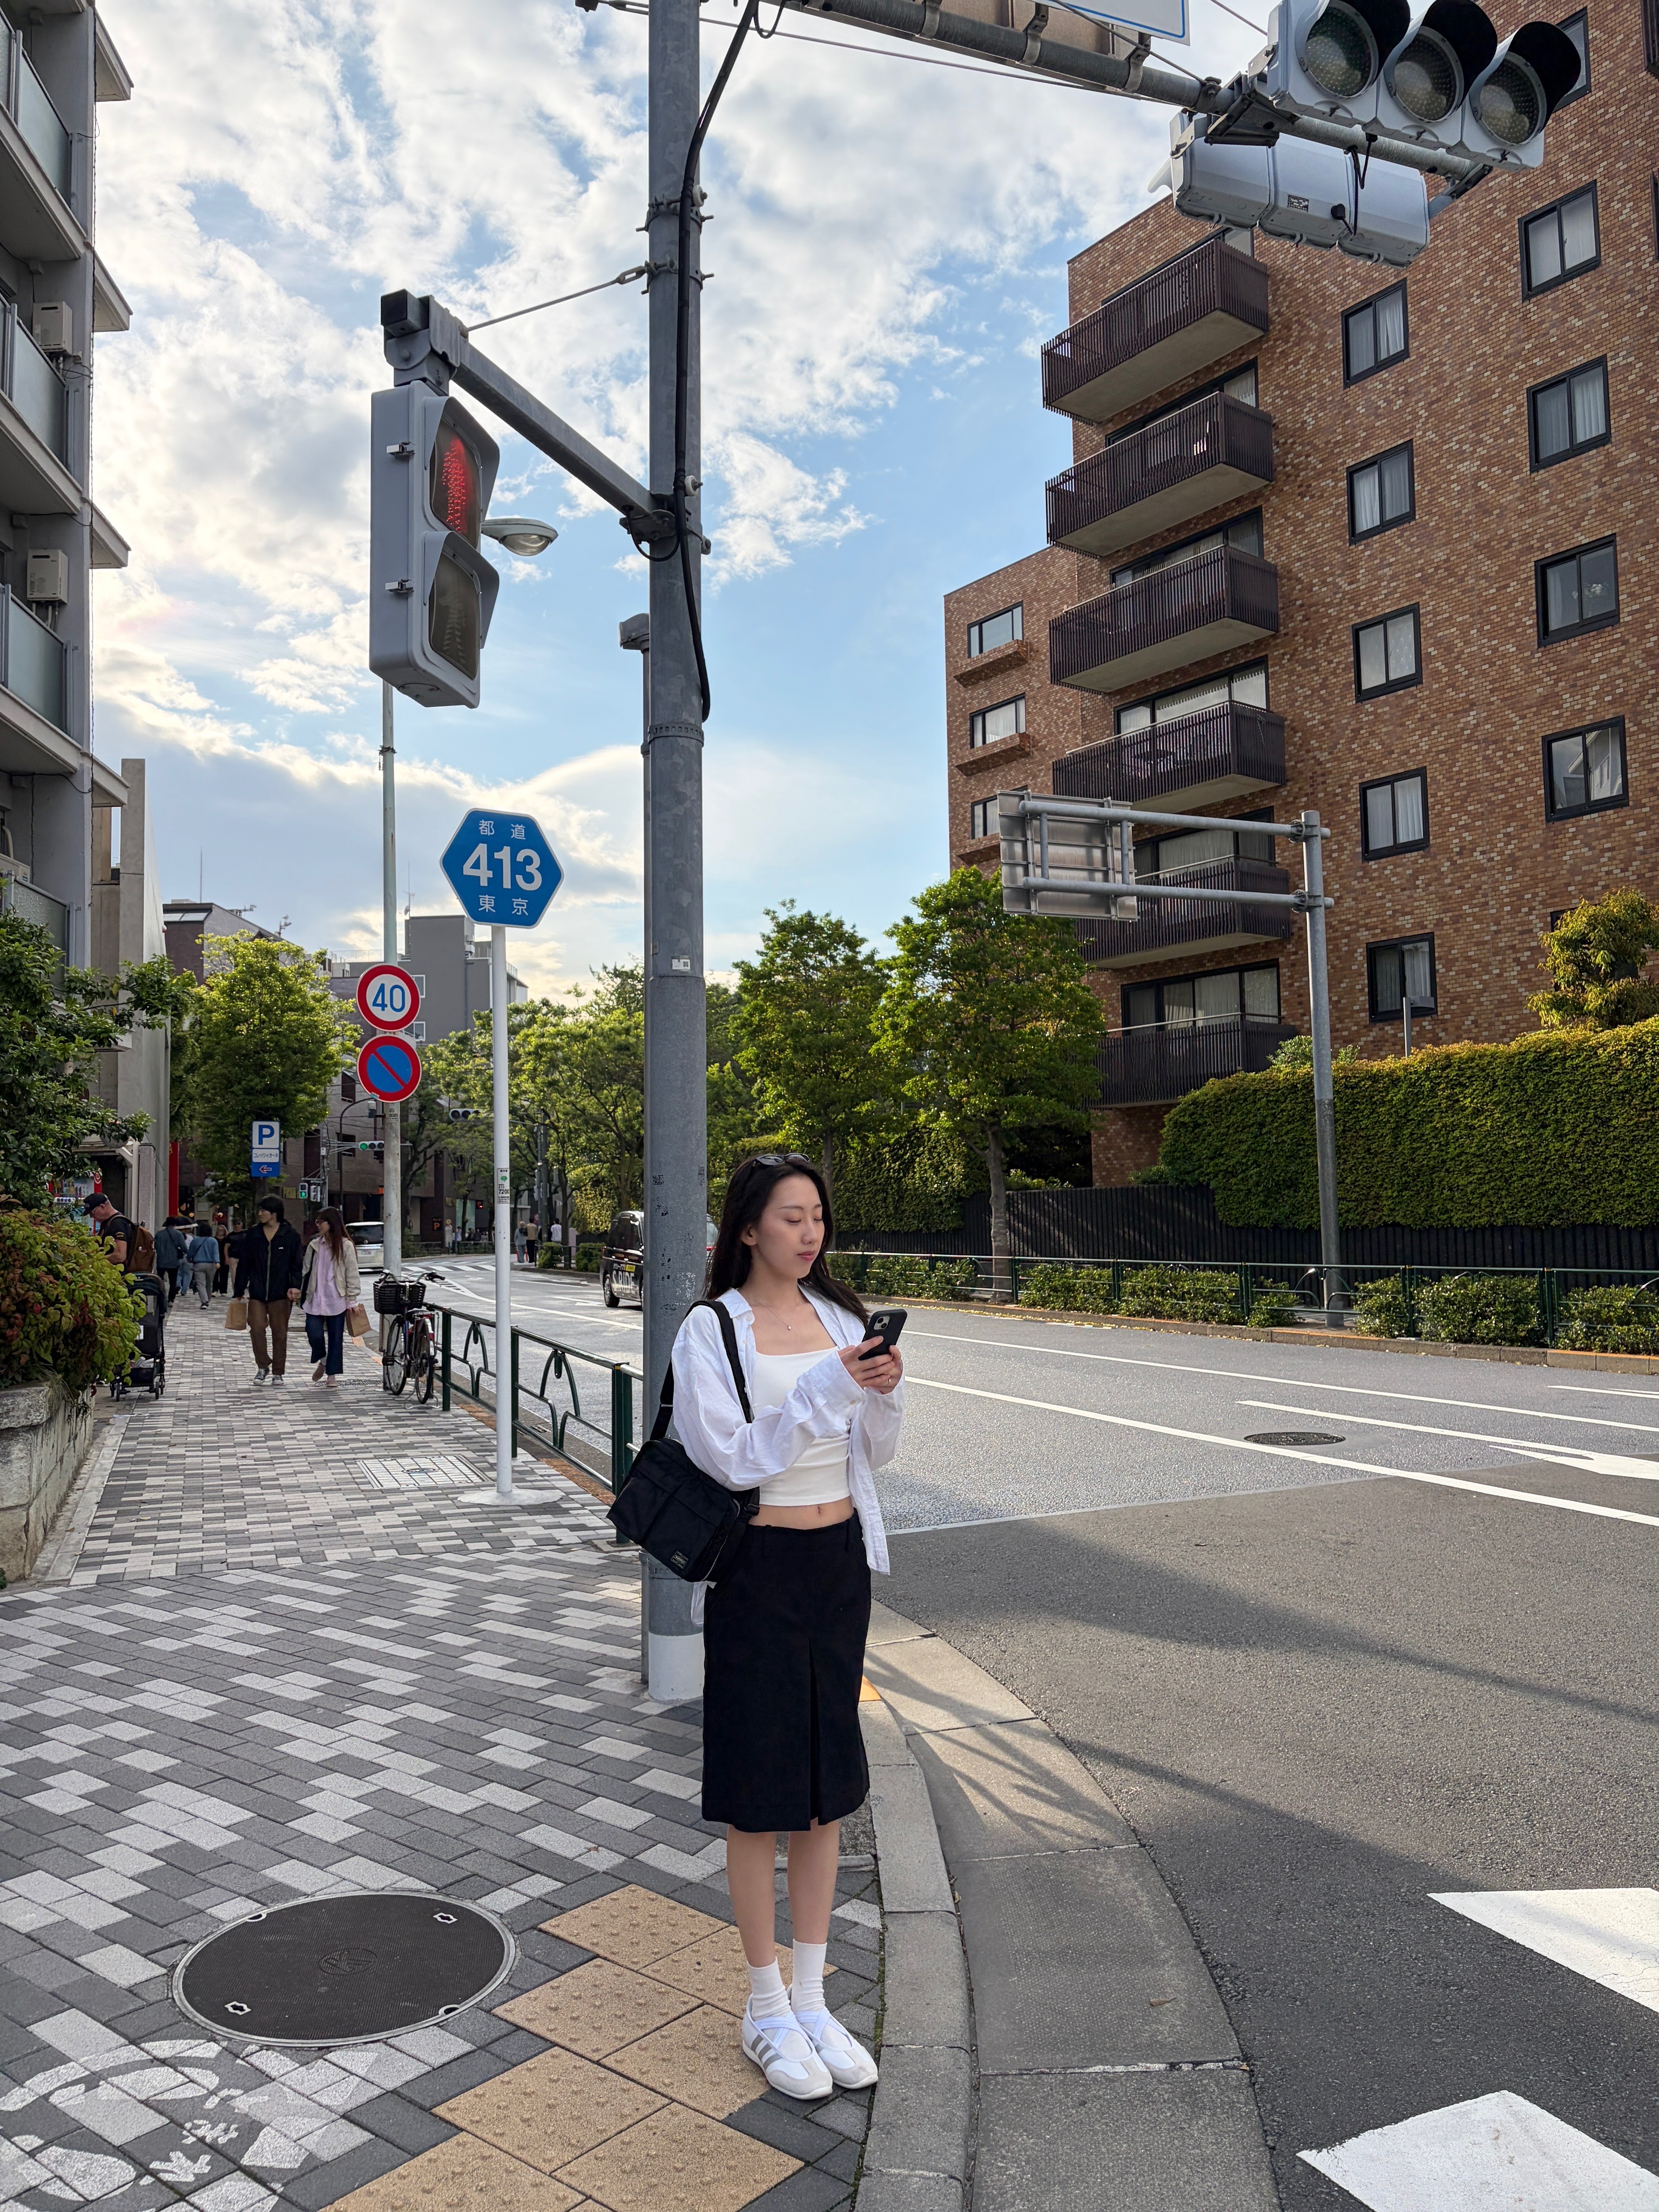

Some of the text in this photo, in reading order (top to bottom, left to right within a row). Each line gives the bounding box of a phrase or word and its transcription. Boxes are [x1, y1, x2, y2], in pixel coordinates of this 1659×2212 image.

[463, 842, 542, 891] 413
[372, 983, 406, 1013] 40
[258, 1124, 275, 1145] P
